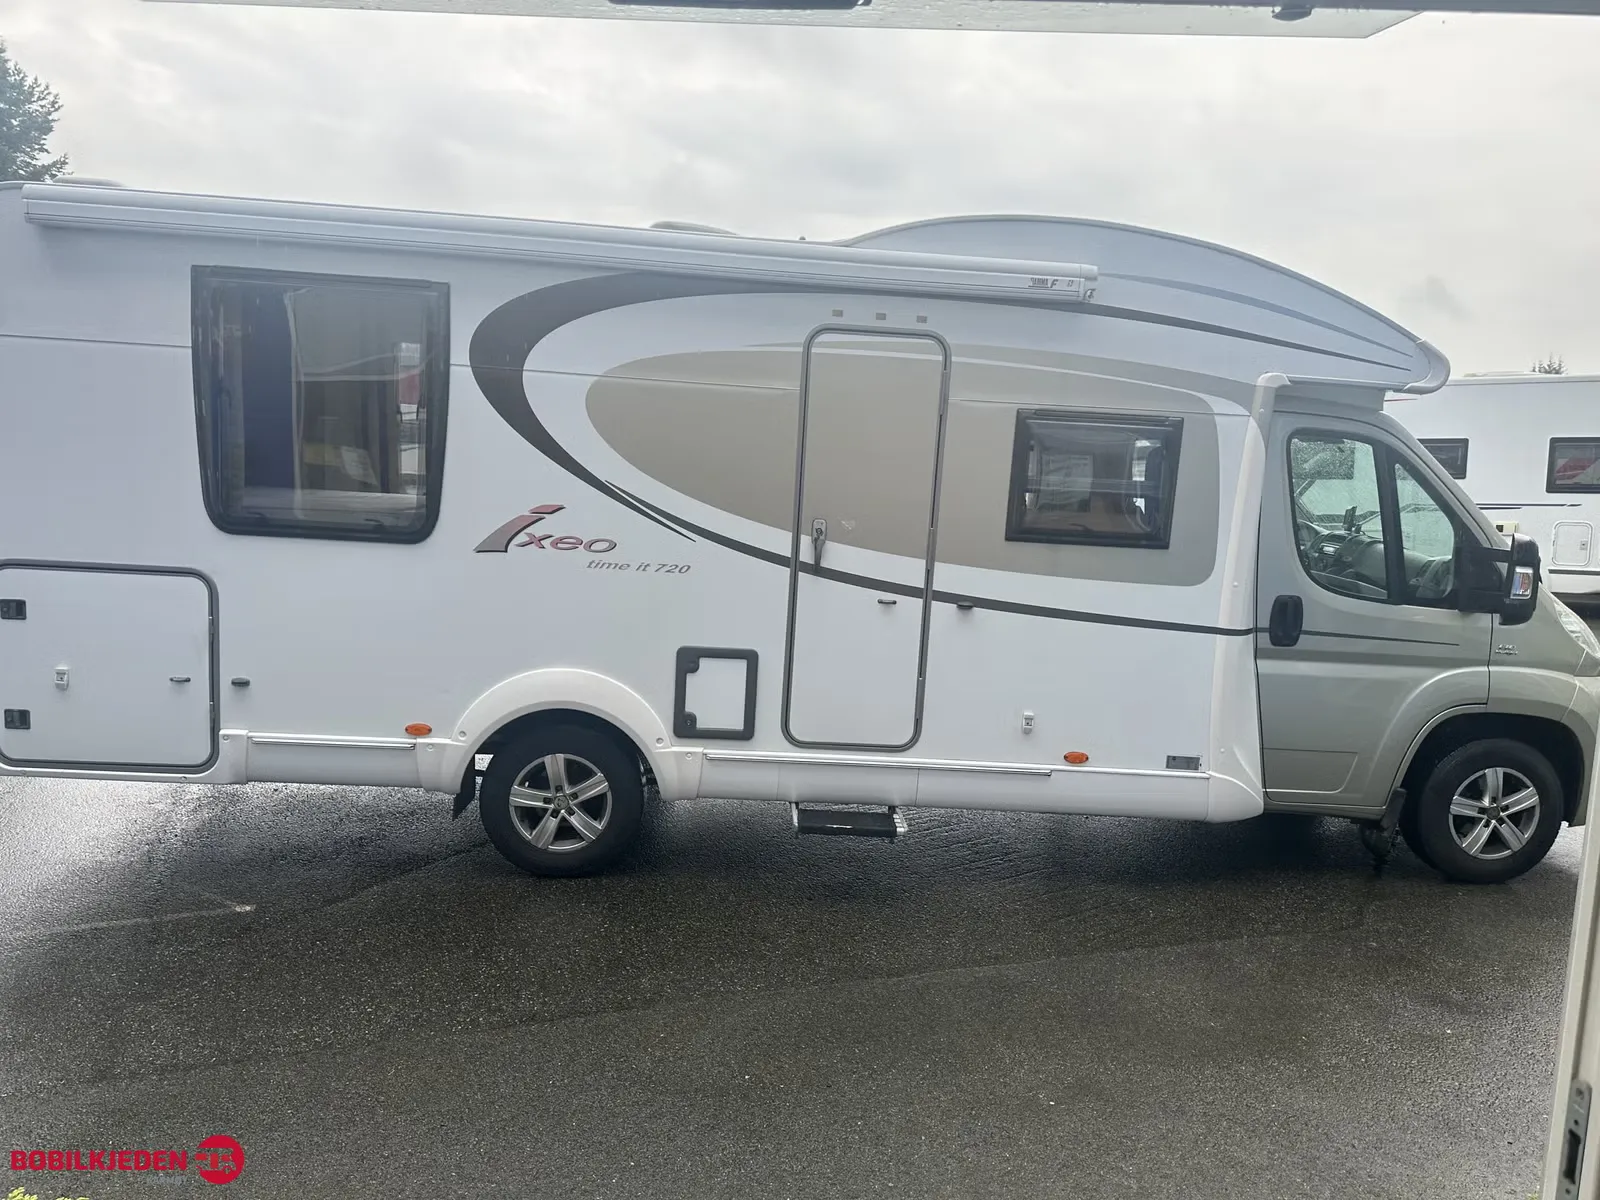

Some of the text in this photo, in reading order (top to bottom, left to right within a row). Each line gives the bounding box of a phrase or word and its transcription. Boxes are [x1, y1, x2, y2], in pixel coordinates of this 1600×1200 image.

[586, 559, 691, 574] time it 720
